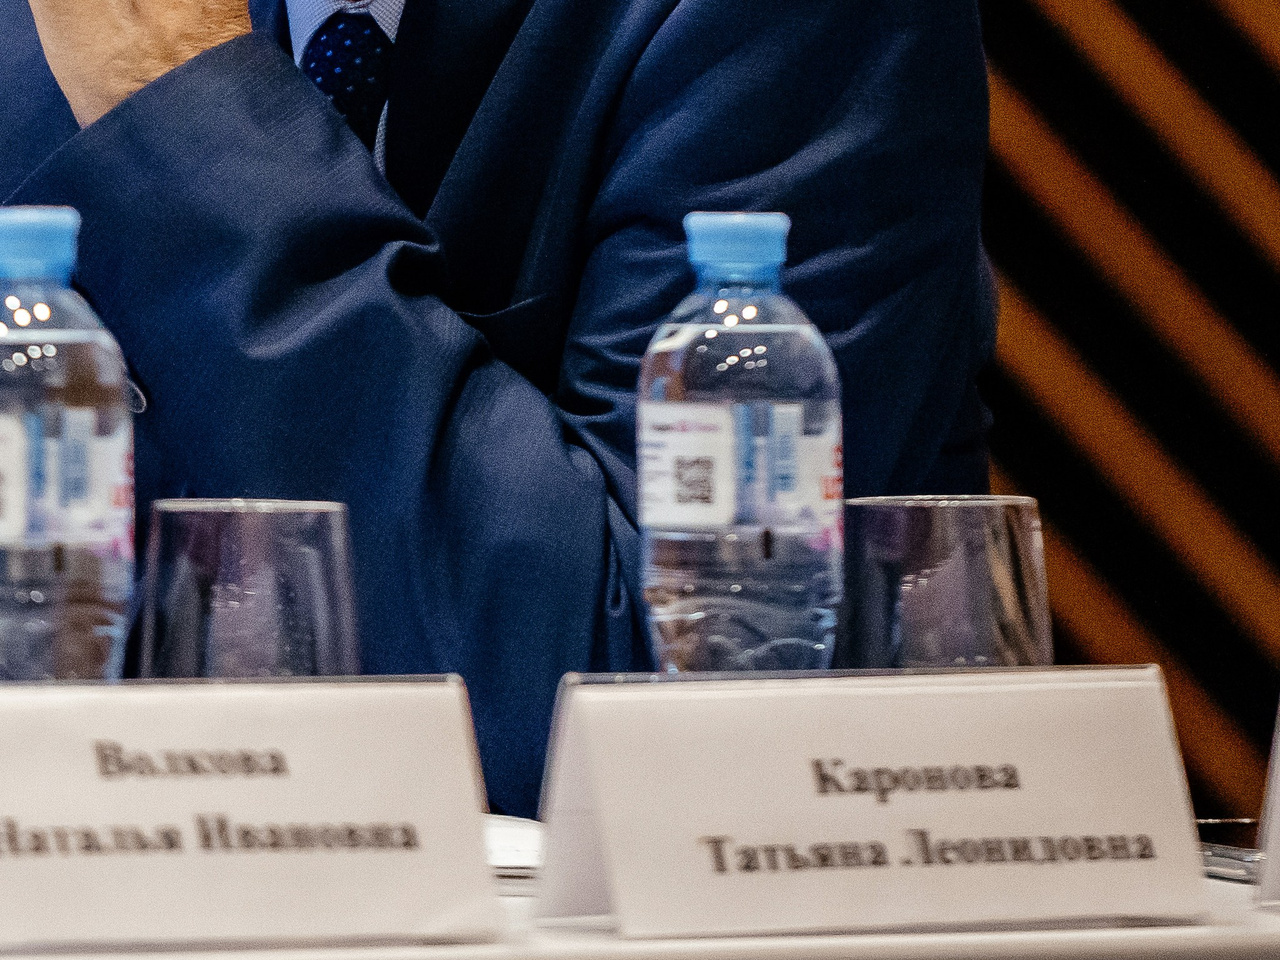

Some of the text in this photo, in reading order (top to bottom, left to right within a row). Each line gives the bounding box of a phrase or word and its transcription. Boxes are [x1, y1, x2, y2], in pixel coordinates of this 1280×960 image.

[93, 740, 289, 781] Волкова
[811, 757, 1021, 803] Каронова
[194, 812, 420, 853] Ивановна
[699, 828, 1157, 874] Татьяна Леонидовна
